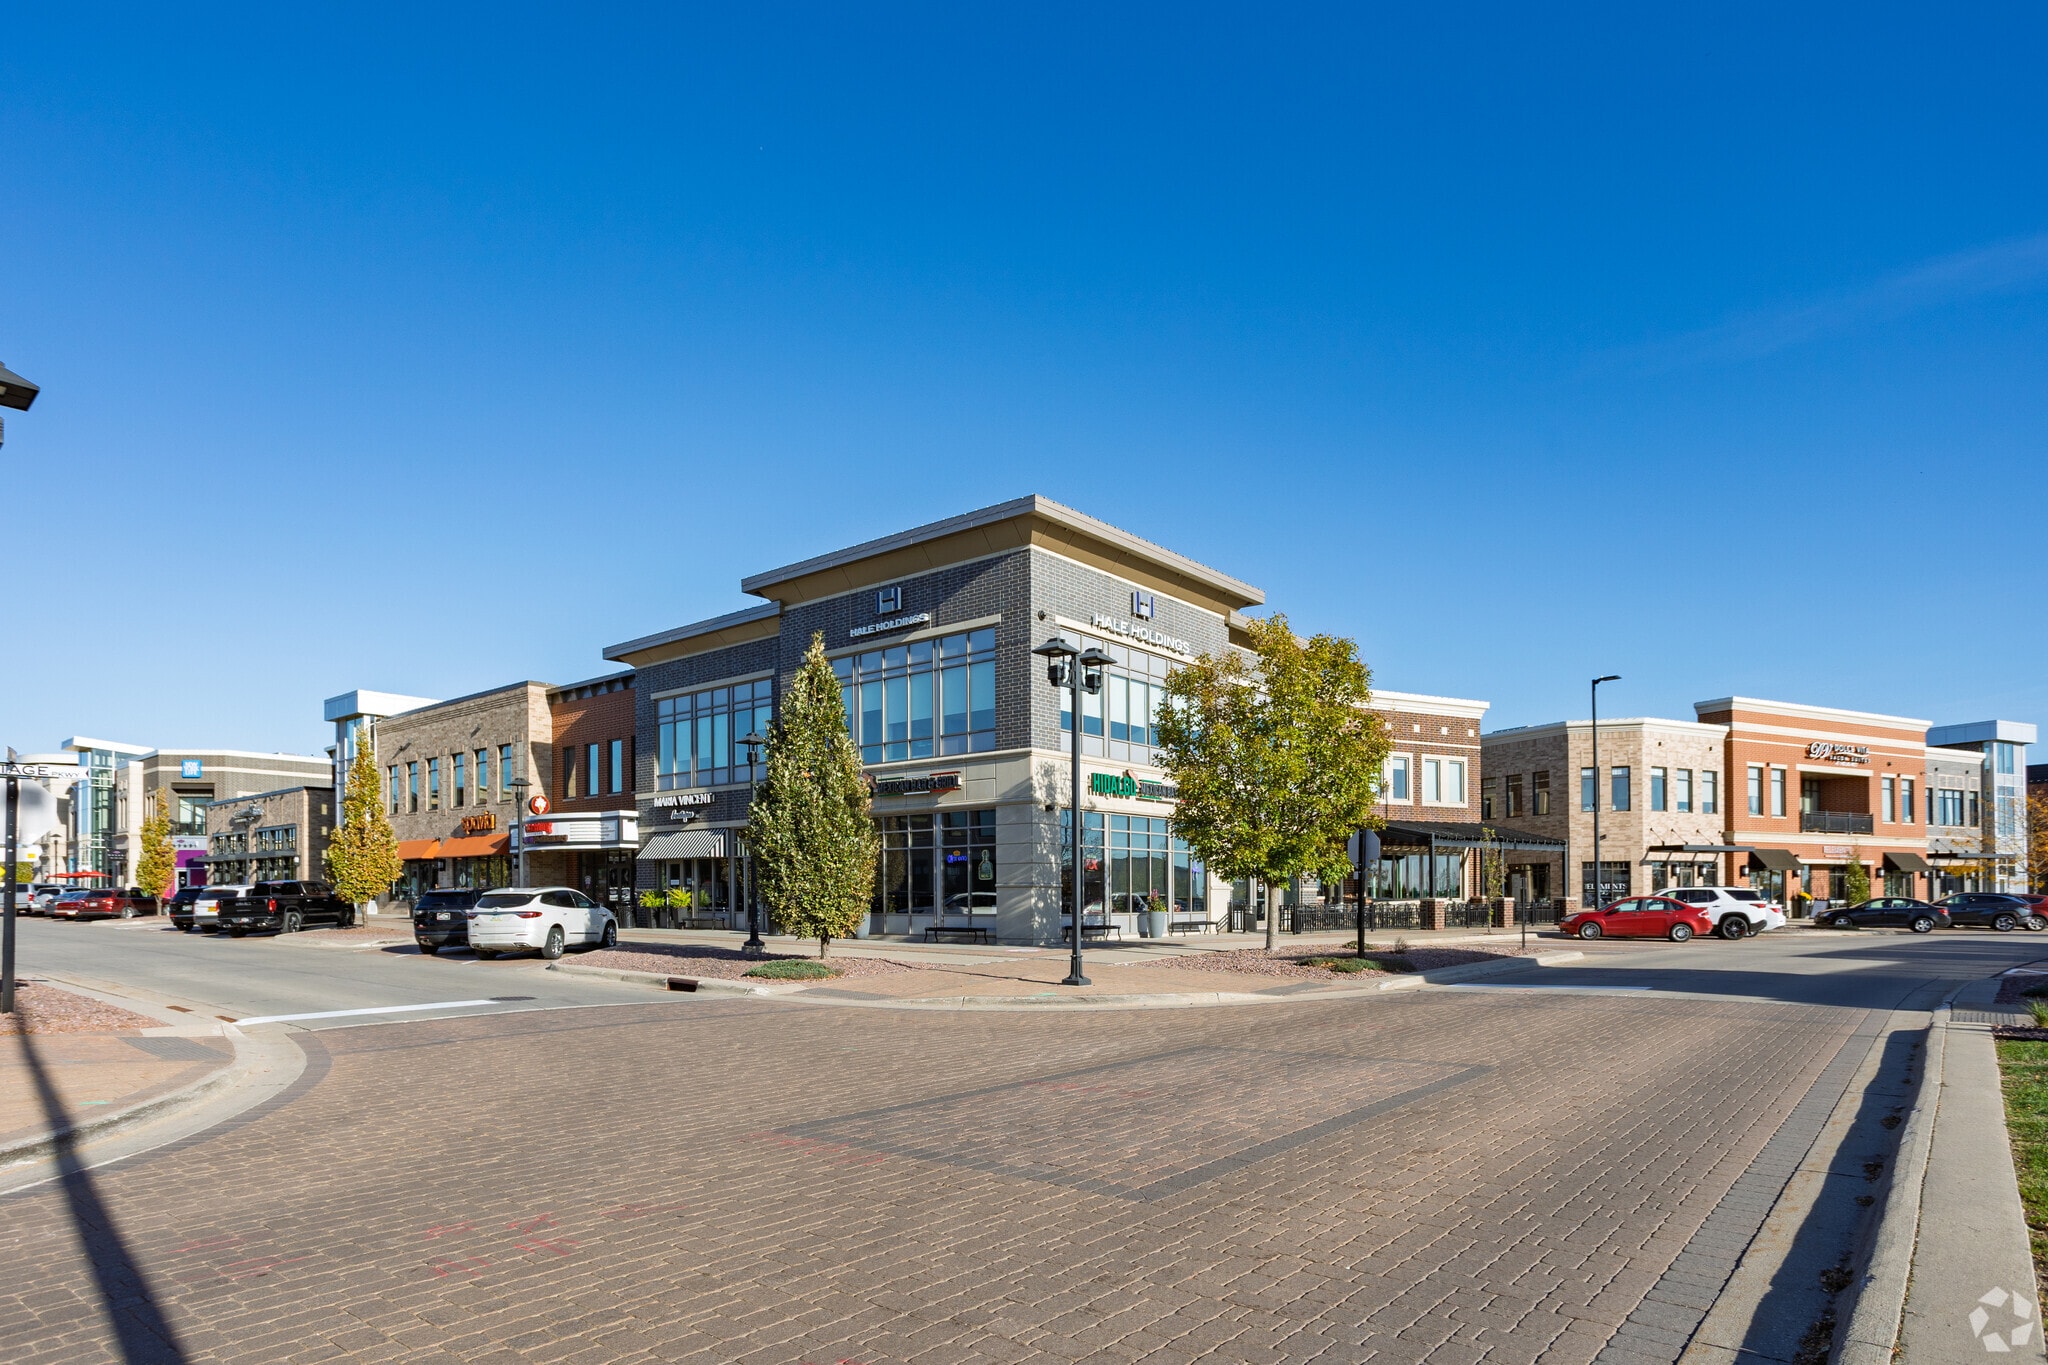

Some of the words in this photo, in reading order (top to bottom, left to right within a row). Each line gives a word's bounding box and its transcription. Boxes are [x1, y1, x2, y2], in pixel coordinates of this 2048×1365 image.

[850, 624, 876, 638] HALE
[876, 612, 931, 632] HOLDINGS
[1094, 612, 1130, 635] HALE
[1131, 623, 1191, 654] HOLDINGS
[877, 779, 912, 793] MEXICAN
[912, 777, 929, 791] BAR
[936, 774, 959, 788] GRILL
[1092, 772, 1137, 797] HIDALGO
[1140, 783, 1168, 798] MEXICAN
[654, 796, 678, 807] MARIA
[678, 792, 713, 806] VINCENT
[1584, 882, 1627, 890] ELMENTS
